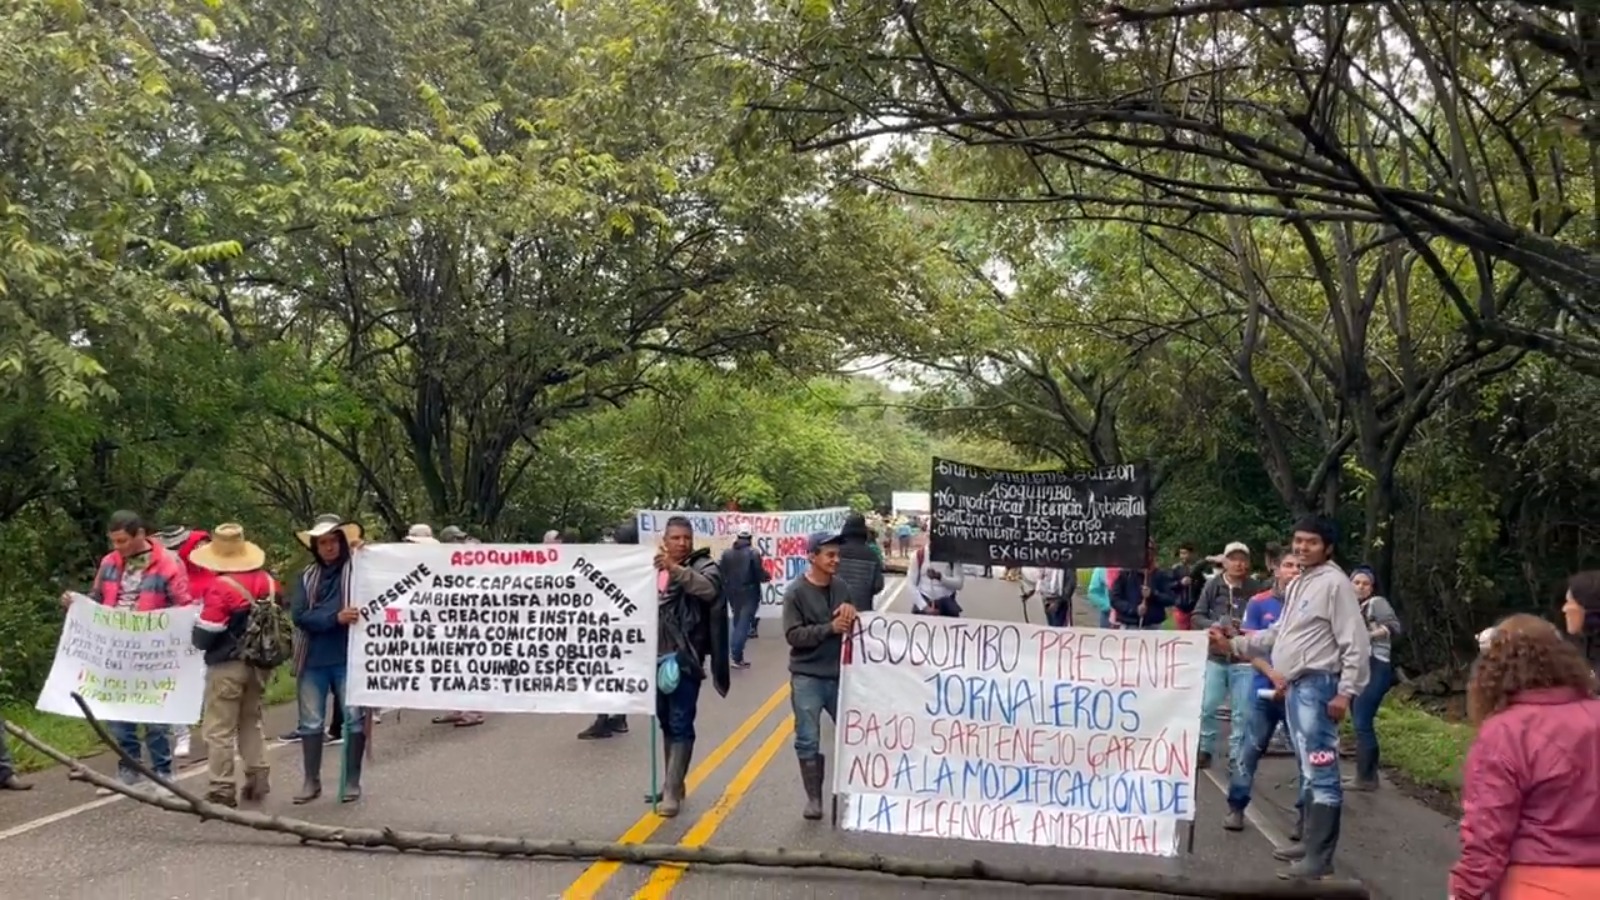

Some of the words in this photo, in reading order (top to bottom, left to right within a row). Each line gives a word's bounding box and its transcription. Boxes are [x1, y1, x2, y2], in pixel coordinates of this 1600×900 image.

[938, 486, 955, 508] No
[641, 513, 660, 533] EL
[758, 537, 772, 557] SE
[1088, 531, 1116, 545] 1277
[451, 549, 558, 566] ASOQUIMBO
[360, 563, 431, 622] PRESENTE
[572, 557, 638, 617] PRESENTE
[410, 591, 541, 607] AMBIENTALISTA
[547, 593, 594, 608] HOBO
[411, 610, 431, 623] LA
[438, 609, 519, 624] CREACION
[366, 625, 404, 638] CION
[413, 625, 436, 639] DE
[445, 626, 480, 640] UNA
[485, 627, 567, 642] COMICION
[578, 627, 622, 643] PARA
[626, 628, 645, 644] EL
[365, 641, 487, 656] CUMPLIMIENTO
[492, 642, 513, 656] DE
[517, 643, 549, 658] LAS
[555, 644, 632, 659] OBLIGA-
[844, 616, 1021, 674] ASOQUIMBO
[1031, 630, 1194, 690] PRESENTE
[365, 659, 425, 673] CIONES
[431, 659, 462, 674] DEL
[467, 659, 530, 676] QUIMBO
[367, 676, 420, 691] MENTE
[502, 677, 578, 693] TIERRAS
[582, 677, 592, 691] Y
[595, 678, 649, 693] CENSO
[925, 673, 1140, 732] JORNALEROS
[845, 709, 916, 751] BAJO
[849, 753, 890, 788] NO
[893, 753, 916, 791] A
[916, 755, 956, 796] LA
[963, 758, 1147, 815] MODIFICACIÓN
[1151, 779, 1189, 814] DE
[905, 798, 1021, 841] LICENCIA
[1027, 810, 1157, 853] AMBIENTAL
